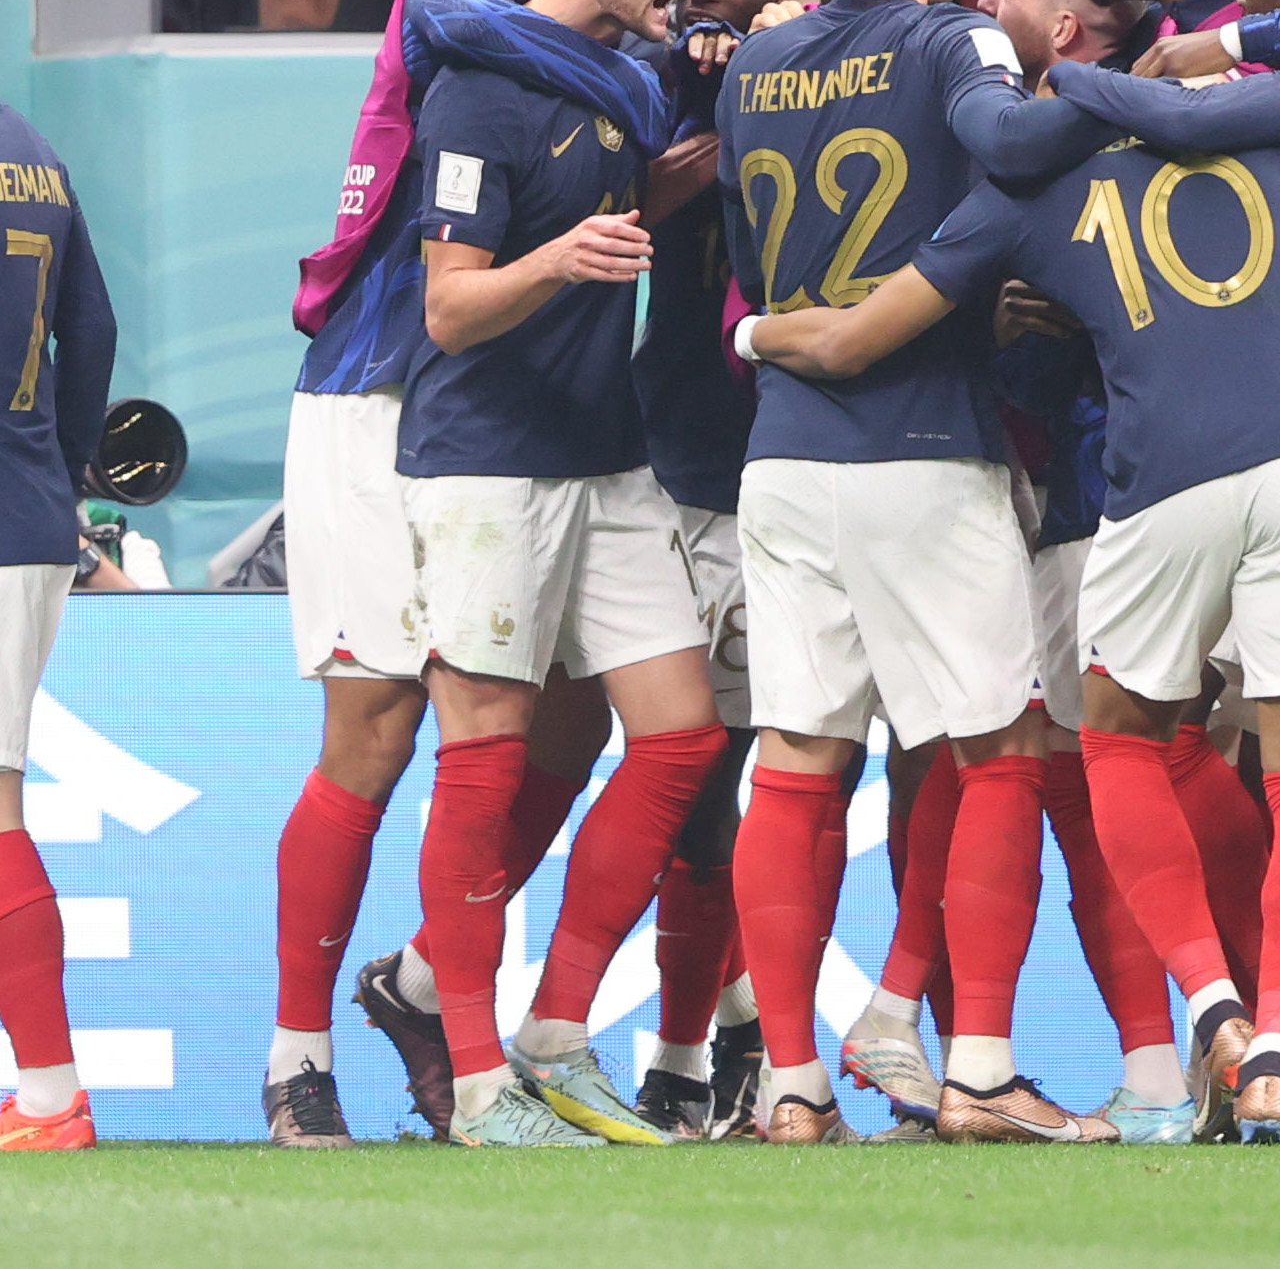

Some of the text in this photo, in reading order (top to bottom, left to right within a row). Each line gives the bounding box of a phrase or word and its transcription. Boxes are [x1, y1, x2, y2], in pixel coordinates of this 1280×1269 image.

[348, 163, 376, 186] CUP
[739, 127, 909, 314] 22
[1071, 154, 1276, 332] 10
[5, 228, 54, 412] 7
